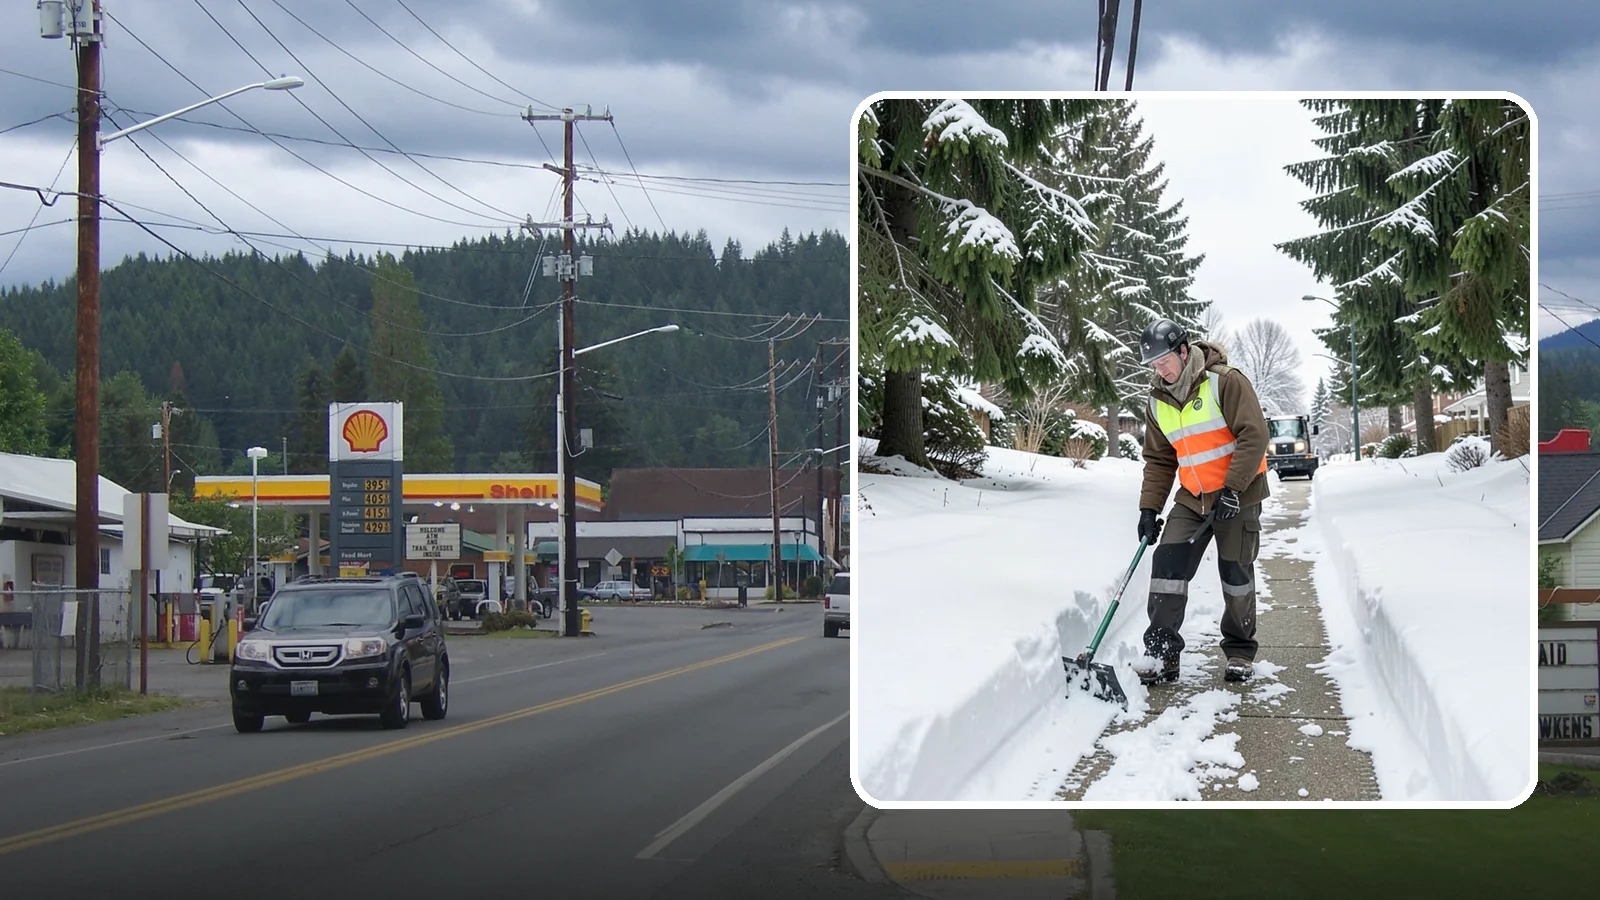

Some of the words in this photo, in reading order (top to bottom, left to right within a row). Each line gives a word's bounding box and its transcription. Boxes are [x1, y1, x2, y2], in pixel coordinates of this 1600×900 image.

[366, 480, 383, 490] 395
[490, 484, 547, 498] Shell
[366, 494, 383, 504] 405
[366, 508, 383, 518] 415
[366, 522, 383, 532] 429
[1538, 642, 1566, 665] AID
